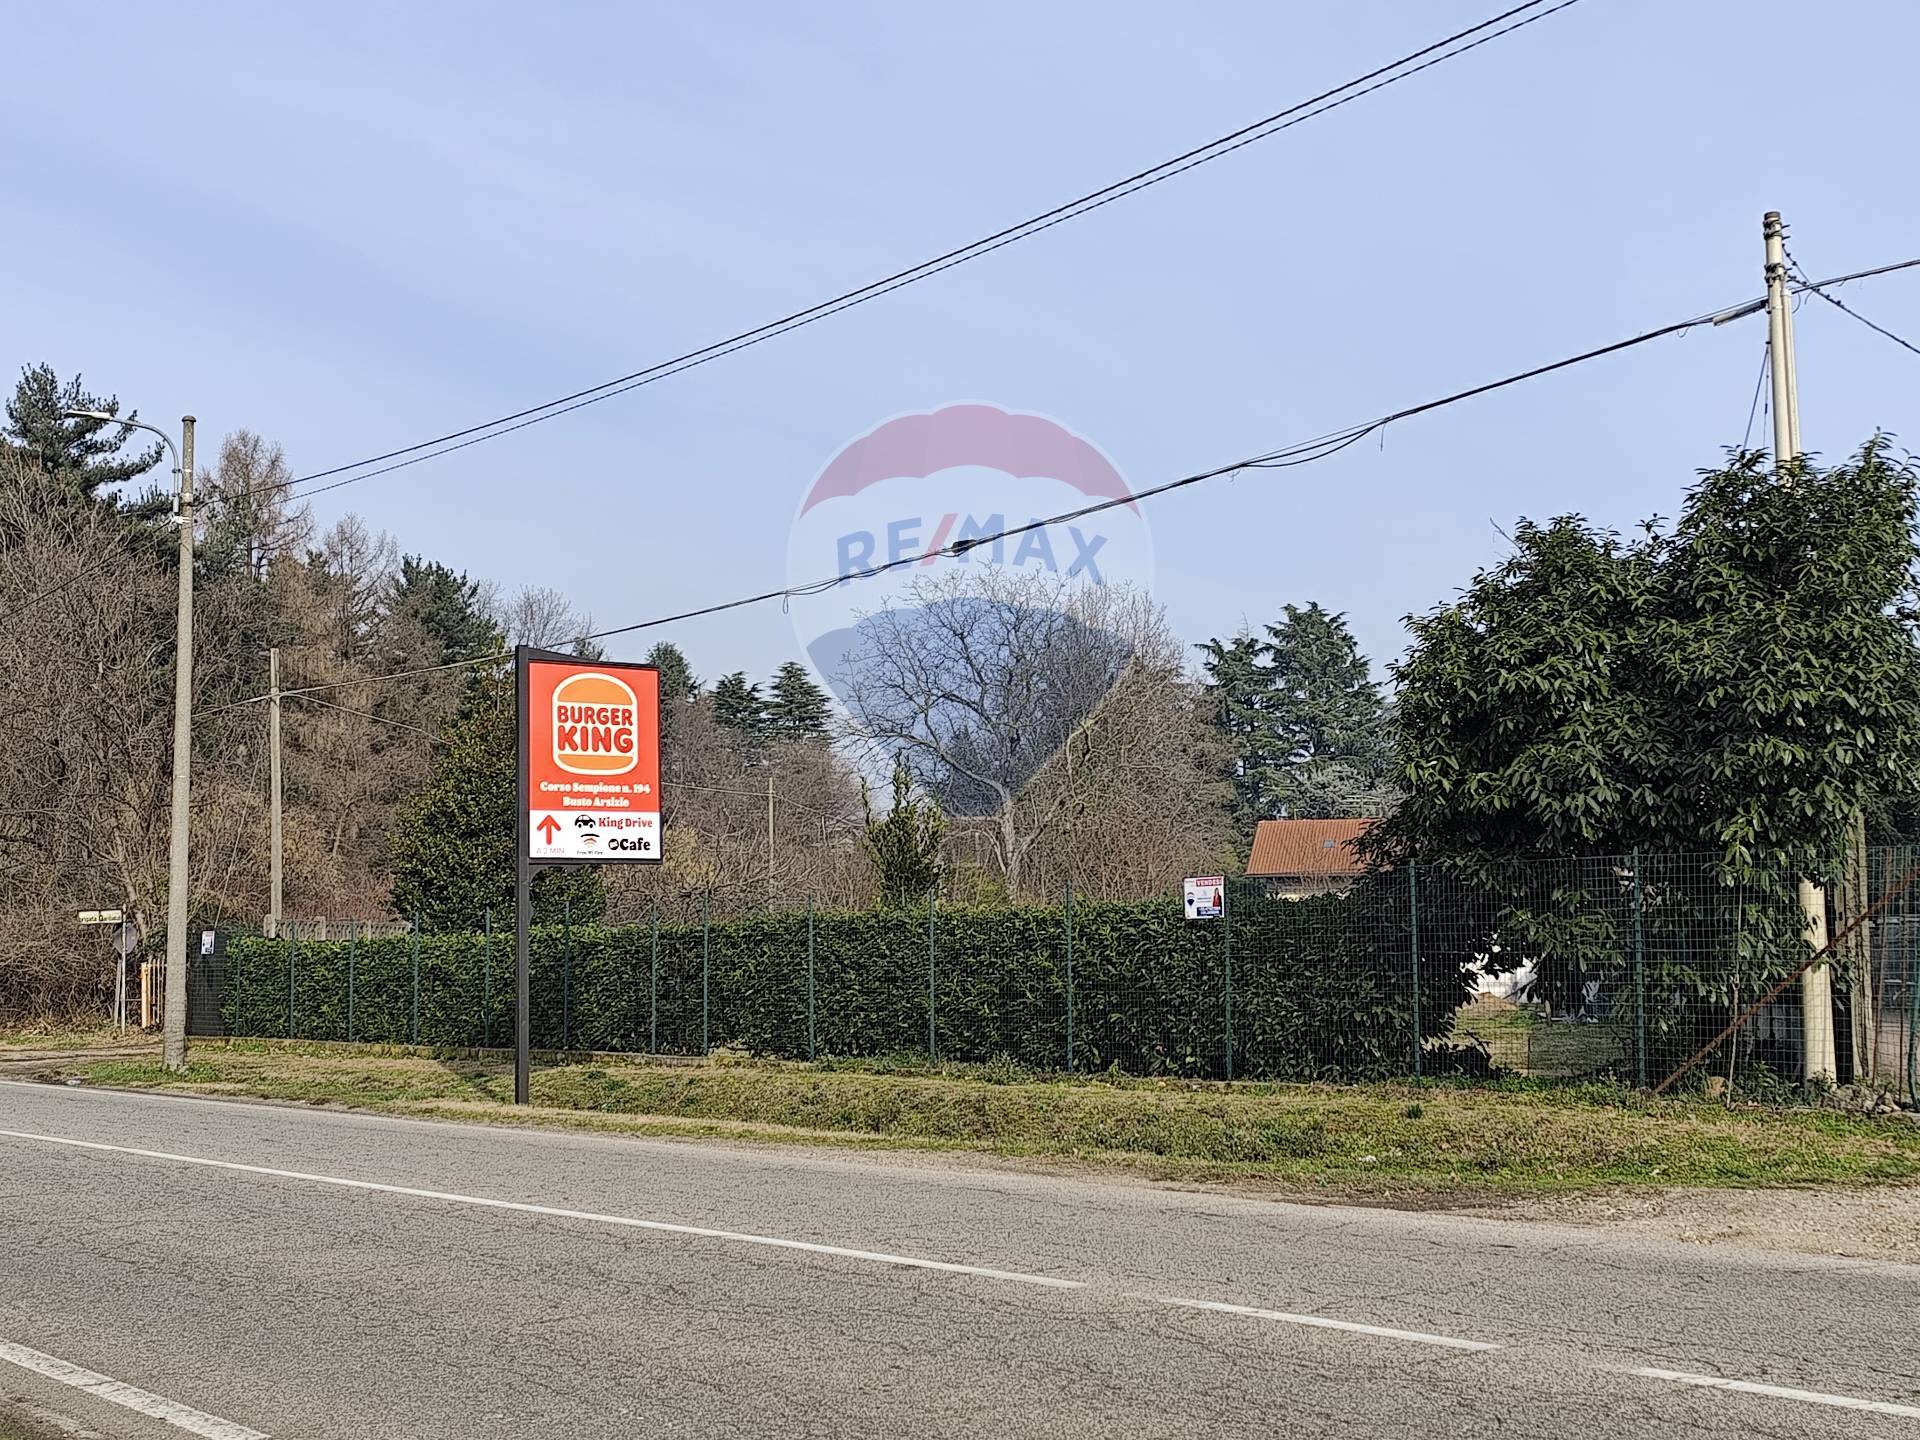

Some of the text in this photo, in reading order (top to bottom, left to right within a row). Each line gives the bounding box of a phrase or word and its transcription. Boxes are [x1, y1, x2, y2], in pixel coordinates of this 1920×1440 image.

[556, 705, 634, 727] BURGER
[557, 725, 634, 754] KING
[540, 781, 571, 792] Corso
[572, 782, 621, 795] Sempione
[633, 783, 651, 794] 194
[562, 796, 630, 807] Busto Arsizio
[598, 817, 653, 829] King Drive
[619, 837, 651, 851] Cafe
